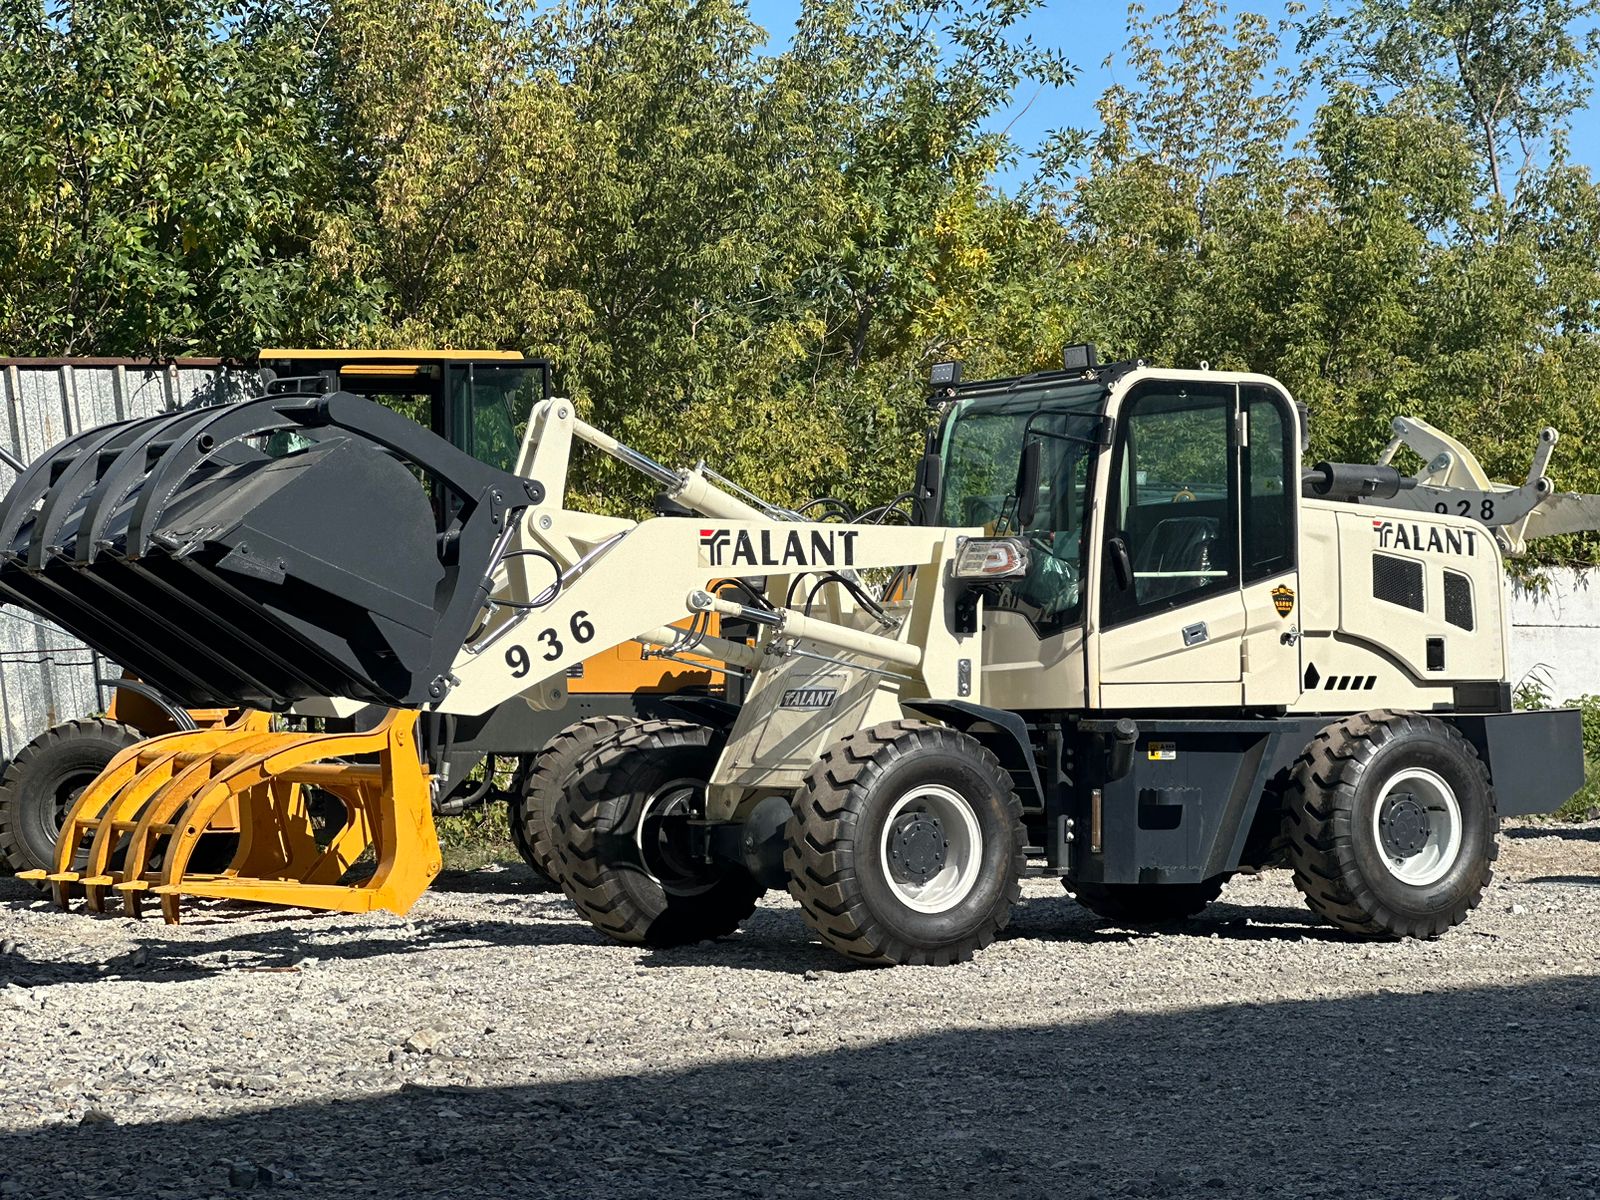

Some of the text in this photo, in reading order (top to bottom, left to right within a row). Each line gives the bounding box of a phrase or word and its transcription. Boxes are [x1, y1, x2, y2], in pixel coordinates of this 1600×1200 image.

[700, 529, 859, 566] TALANT
[1372, 520, 1477, 557] TALANT
[504, 610, 596, 679] 936
[783, 691, 835, 706] TALANT
